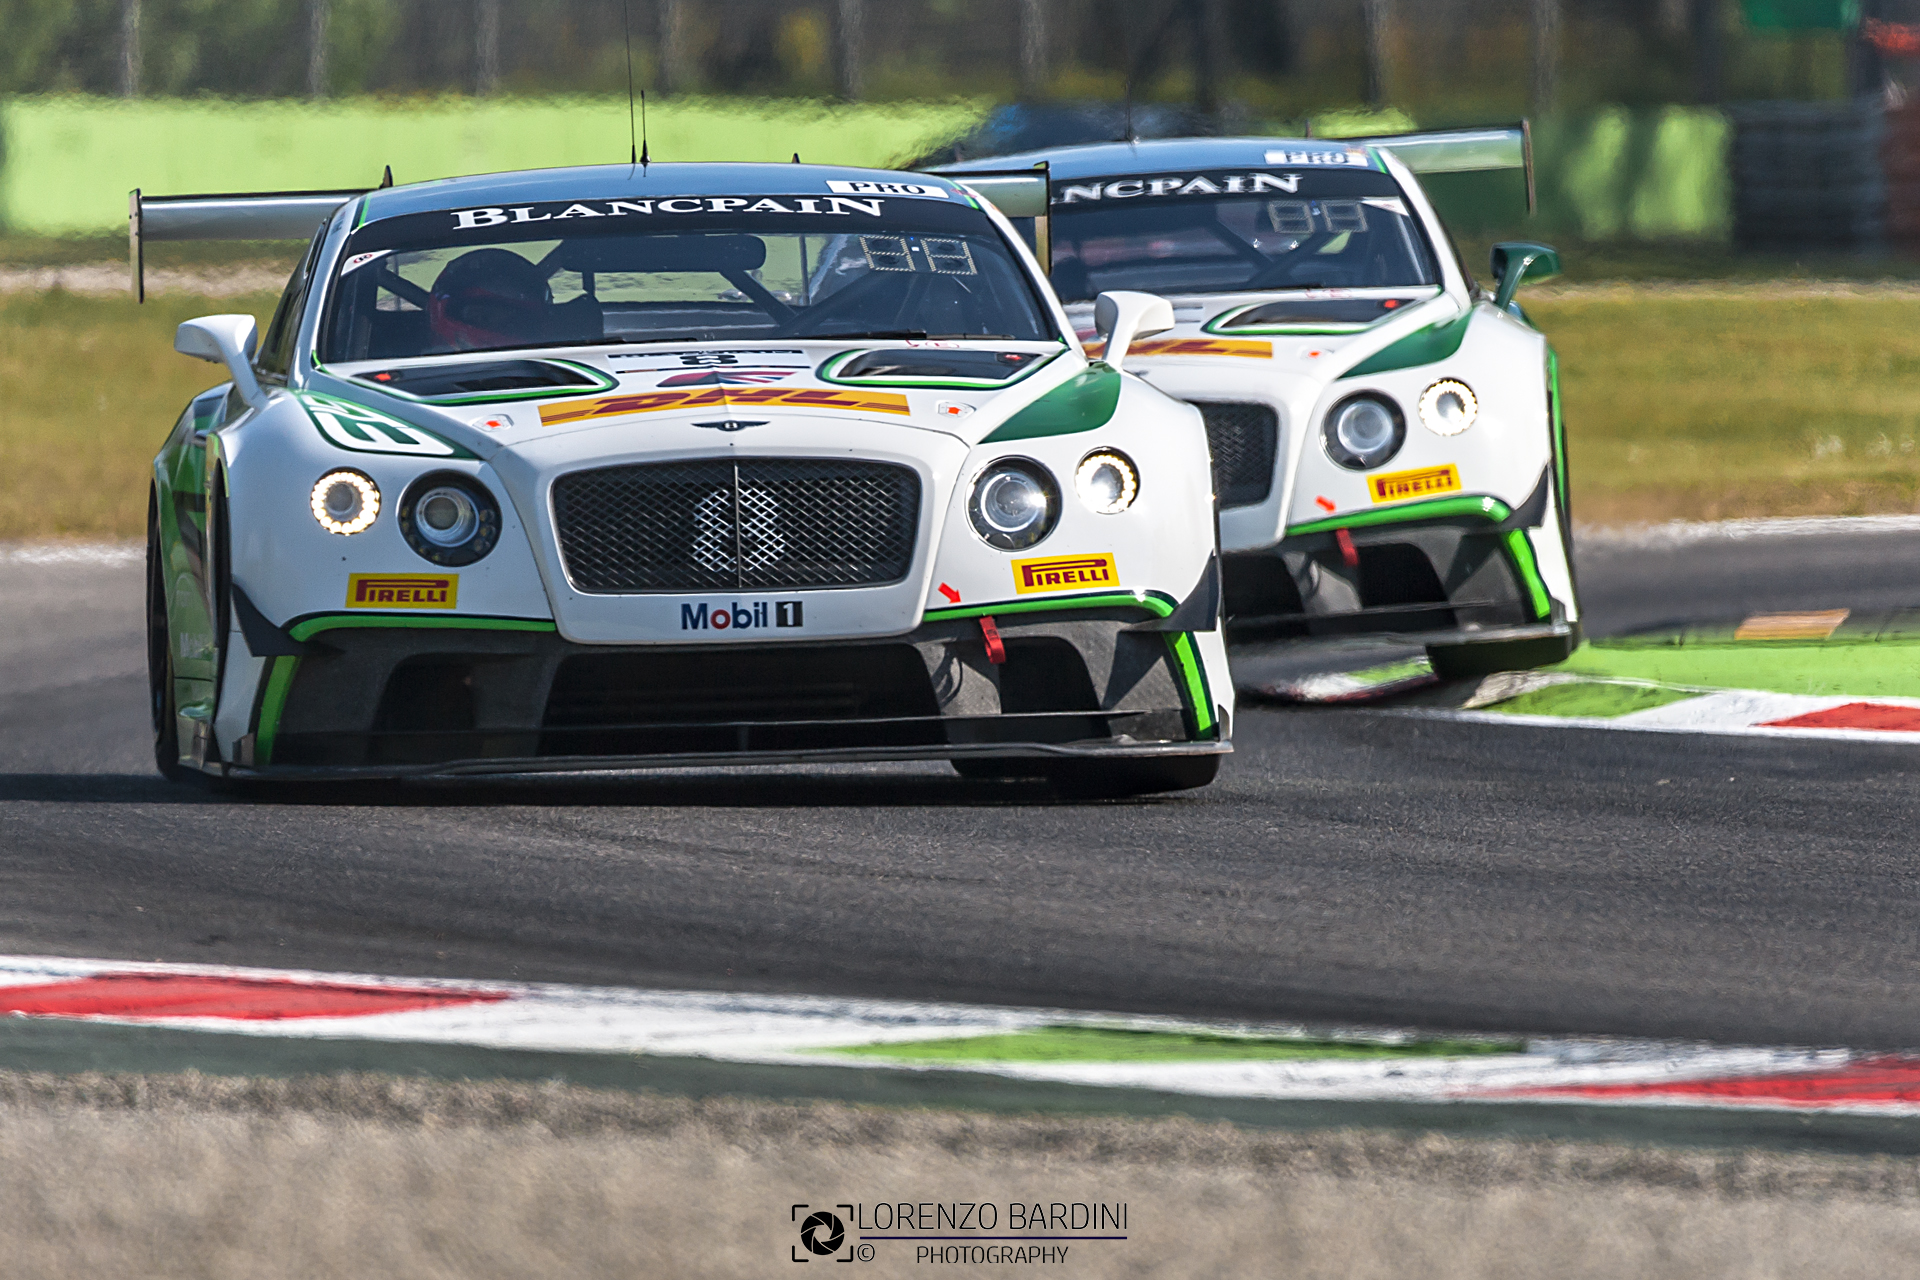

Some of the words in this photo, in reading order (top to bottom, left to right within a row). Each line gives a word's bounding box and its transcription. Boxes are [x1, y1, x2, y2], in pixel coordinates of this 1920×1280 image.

[1285, 150, 1349, 164] PRO
[848, 182, 926, 195] PRO
[1050, 172, 1304, 206] NCPAIN
[452, 196, 886, 231] BLANCPAIN
[679, 353, 739, 366] 8
[591, 388, 860, 416] DHL
[1376, 469, 1453, 498] PIRELLI
[1021, 558, 1110, 588] PIRELLI
[355, 579, 450, 603] PIRELLI
[680, 601, 769, 630] Mobil
